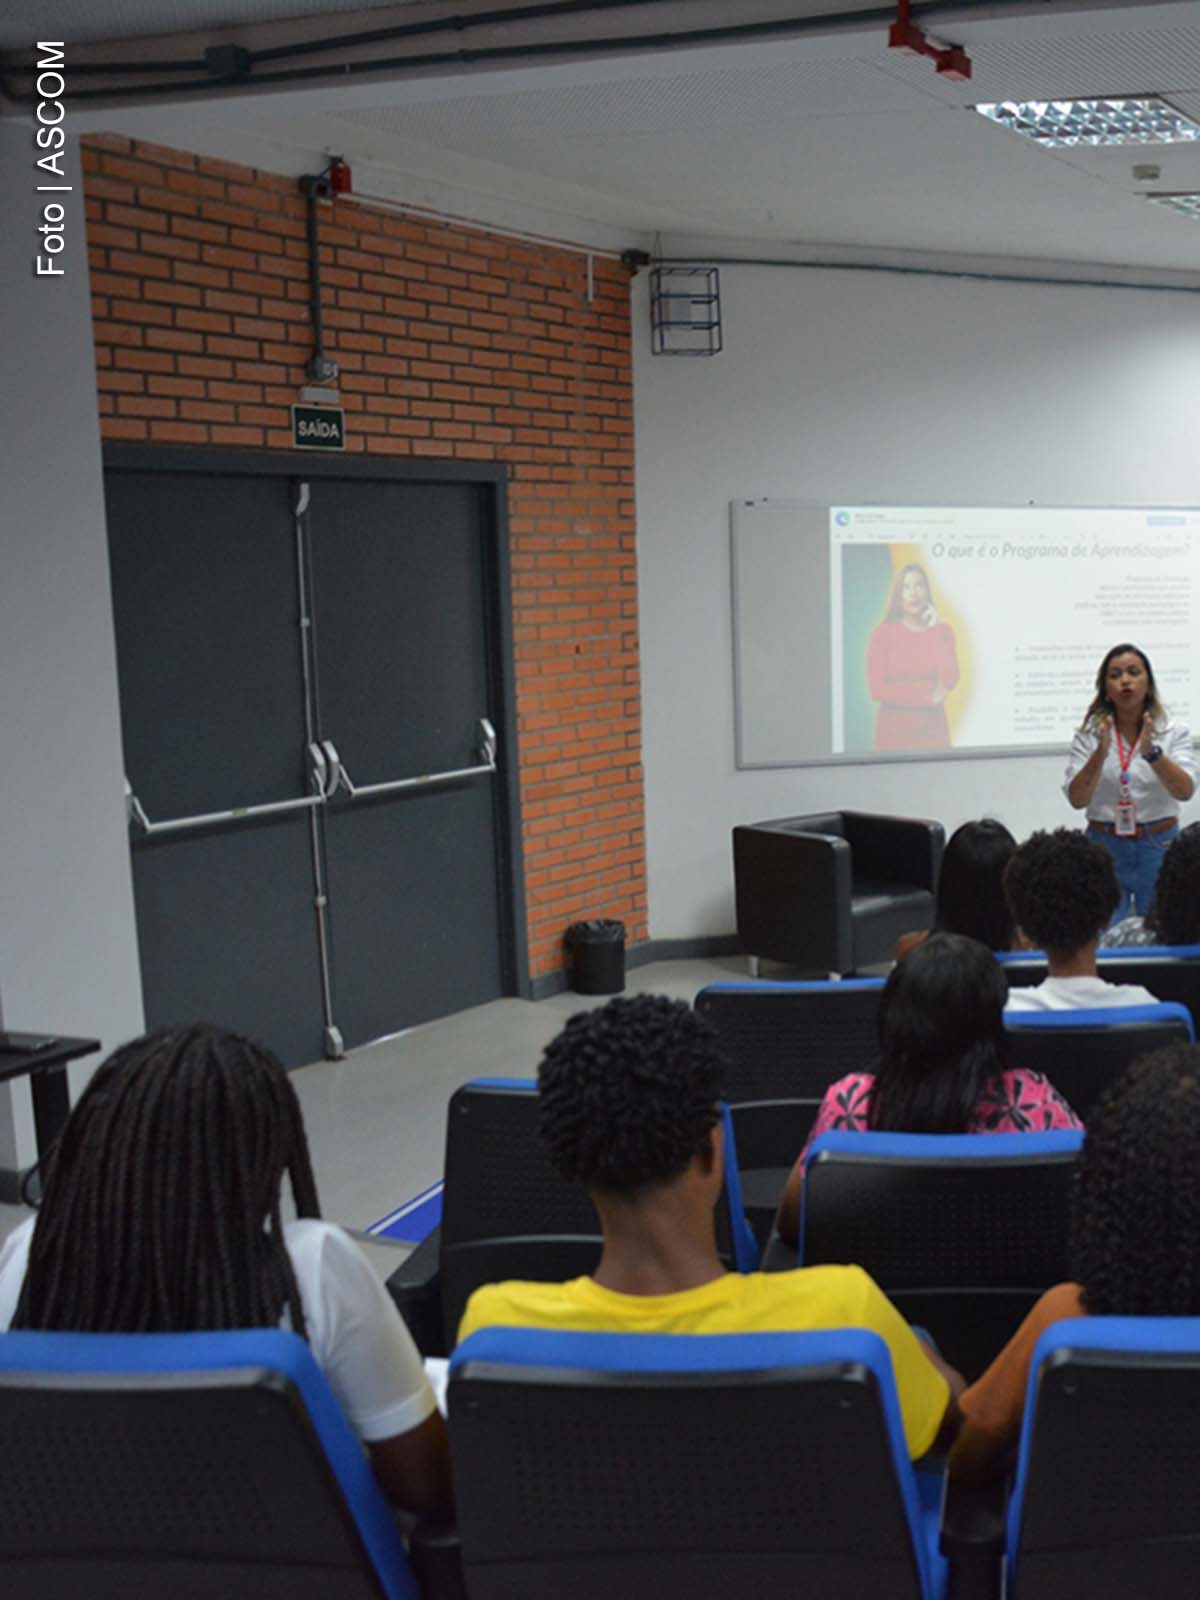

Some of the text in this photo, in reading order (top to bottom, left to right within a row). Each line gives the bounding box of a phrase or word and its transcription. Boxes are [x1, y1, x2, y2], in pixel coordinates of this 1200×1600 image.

[298, 419, 340, 438] SAÍDA
[931, 542, 945, 558] O
[948, 545, 974, 561] que
[977, 542, 987, 558] é
[989, 545, 999, 558] o
[1002, 542, 1069, 561] Programa
[1071, 542, 1087, 558] de
